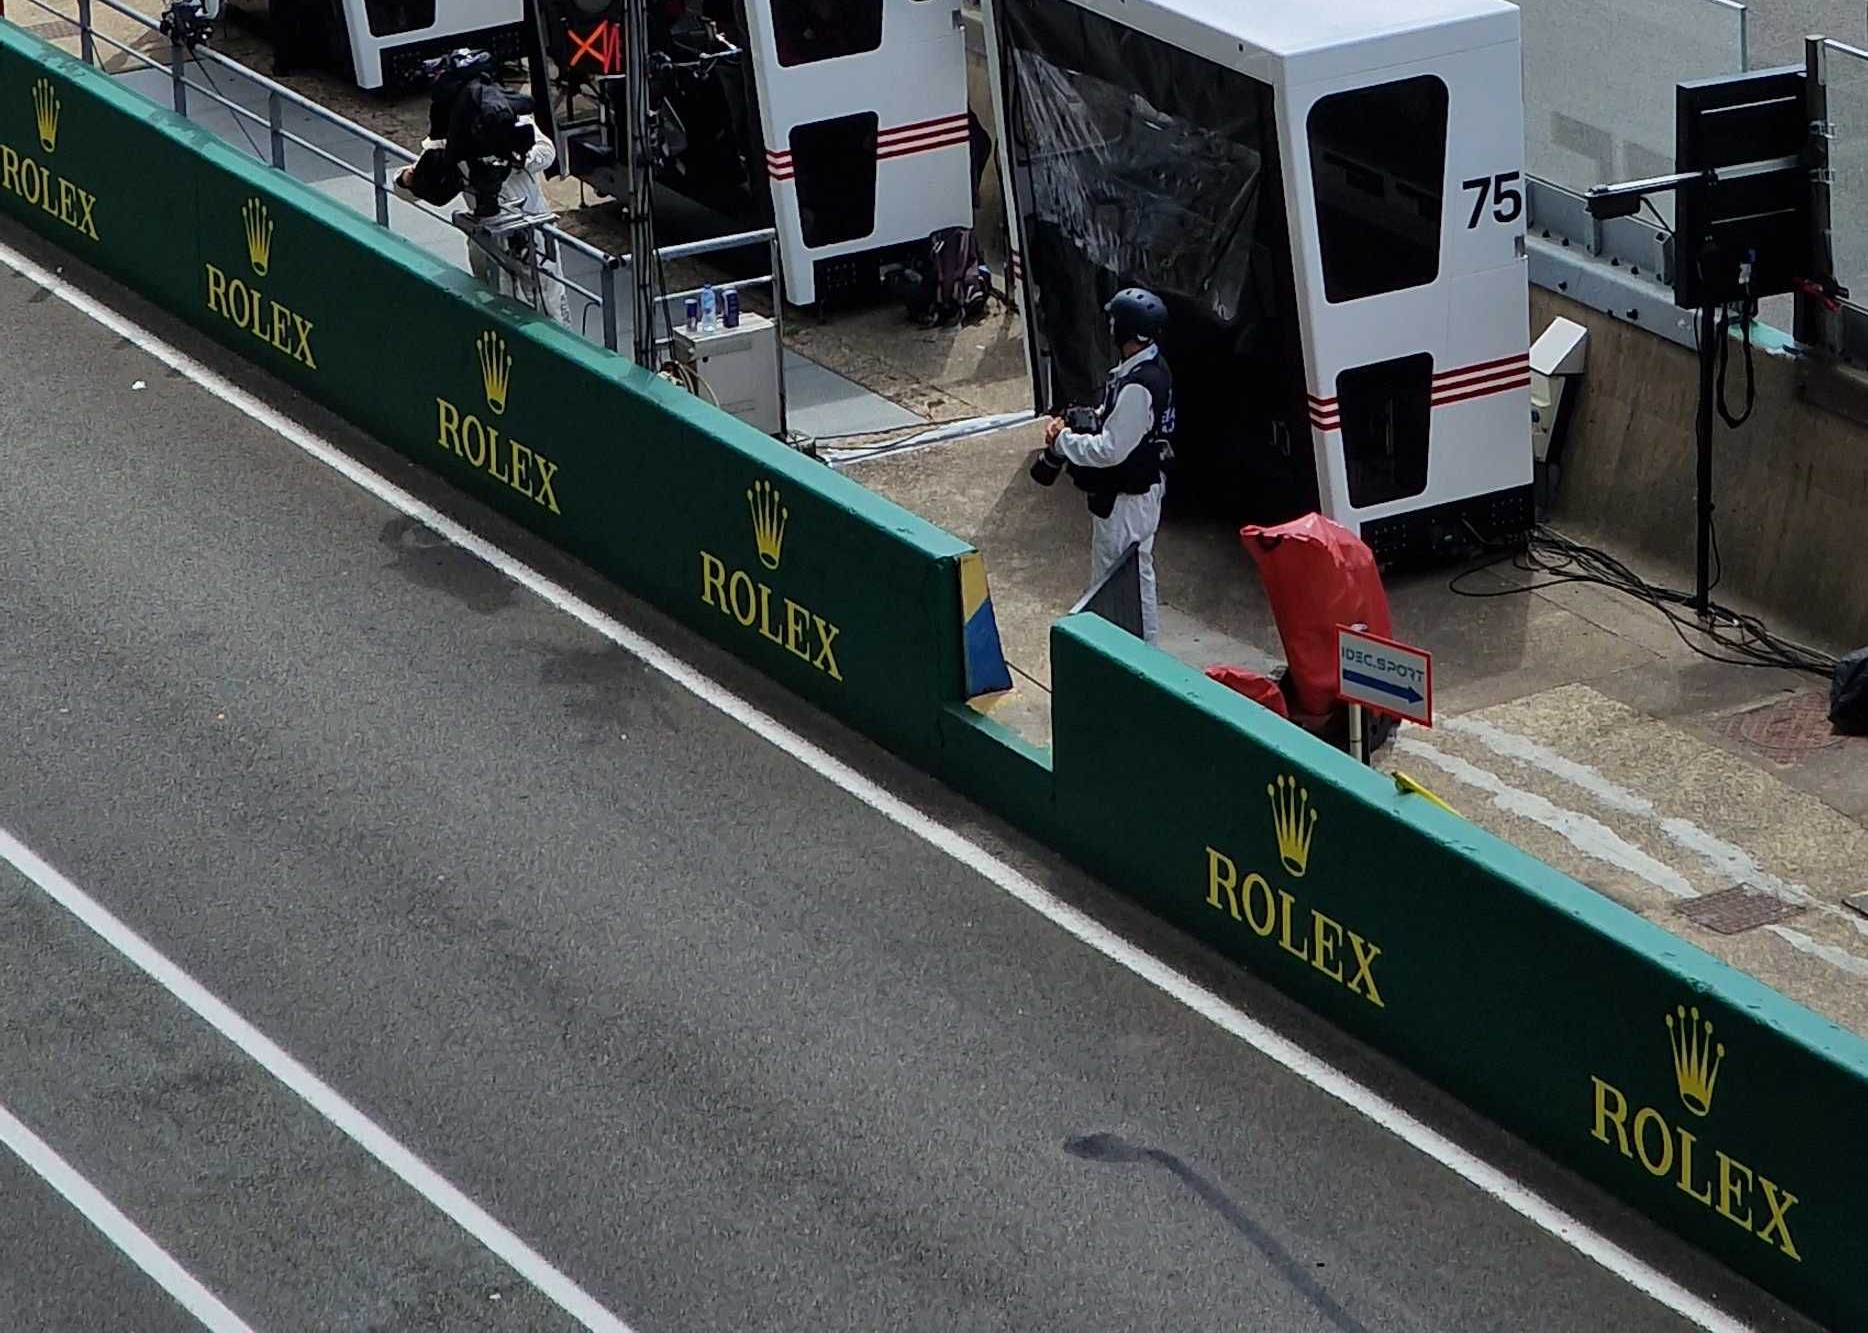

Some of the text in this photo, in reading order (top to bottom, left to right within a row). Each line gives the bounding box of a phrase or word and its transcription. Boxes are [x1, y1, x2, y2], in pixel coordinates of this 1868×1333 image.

[0, 144, 100, 242] ROLEX
[1463, 171, 1522, 229] 75
[206, 263, 318, 370] ROLEX
[436, 396, 561, 515] ROLEX
[700, 551, 843, 682] ROLEX
[1342, 646, 1424, 683] IDEC.SPORT
[1205, 845, 1386, 1009] ROLEX
[1590, 1074, 1802, 1263] ROLEX
